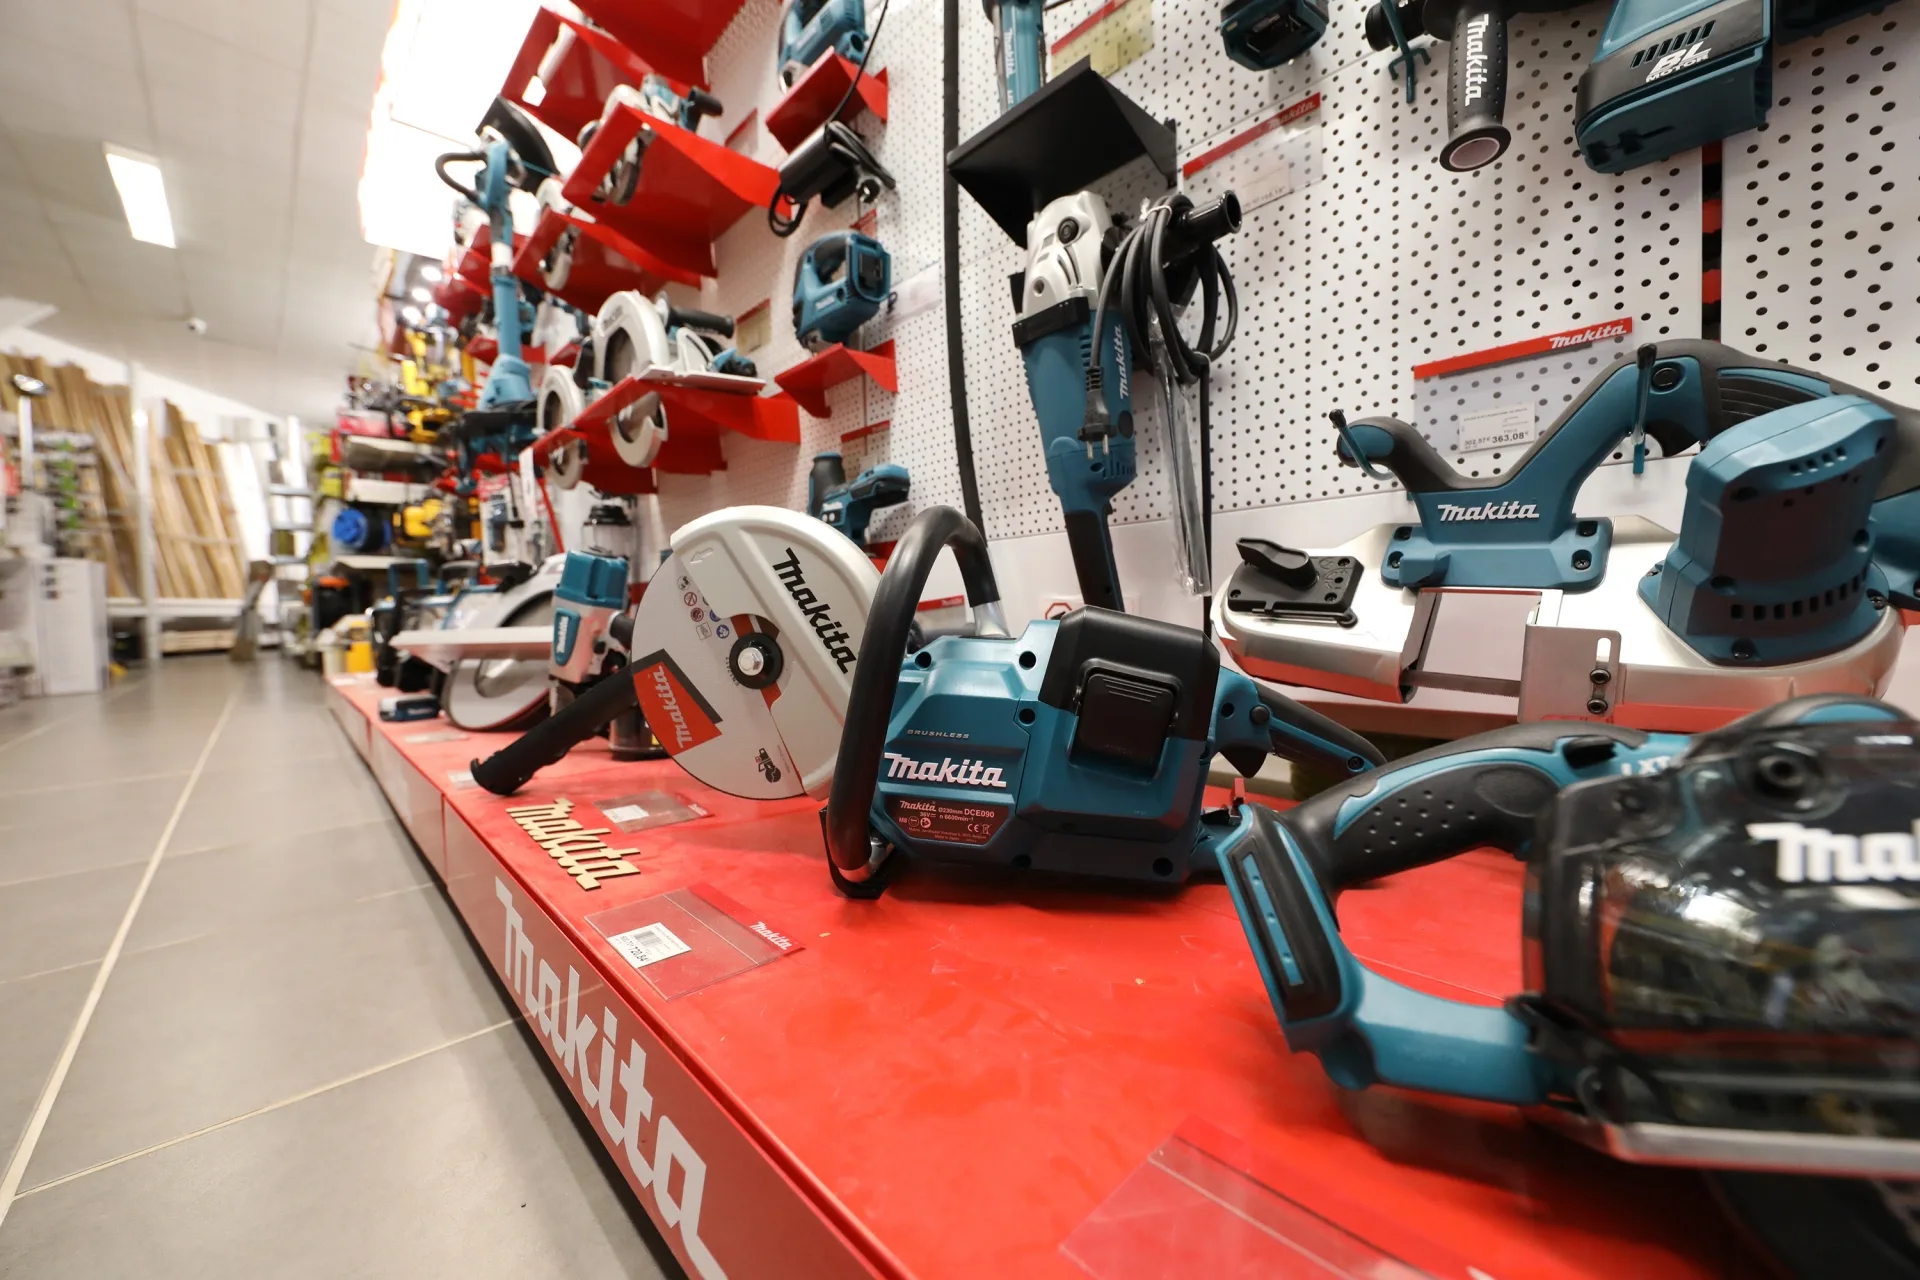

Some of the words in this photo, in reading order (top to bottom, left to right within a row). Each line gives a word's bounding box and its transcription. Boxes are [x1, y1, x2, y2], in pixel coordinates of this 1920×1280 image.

[1465, 13, 1489, 107] Makita
[1645, 51, 1710, 83] MOTOR
[1650, 41, 1711, 74] BL
[1549, 324, 1627, 349] Makita
[1114, 324, 1129, 400] Makita
[1437, 500, 1540, 521] Makita
[772, 547, 857, 675] Makita
[653, 665, 693, 749] Makita
[907, 729, 970, 739] BRUSHLESS
[883, 752, 1007, 788] Makita
[900, 800, 937, 812] Makita
[964, 808, 995, 818] DCE090
[505, 797, 641, 892] Makita
[749, 920, 793, 950] Makita
[495, 876, 728, 1280] Makita
